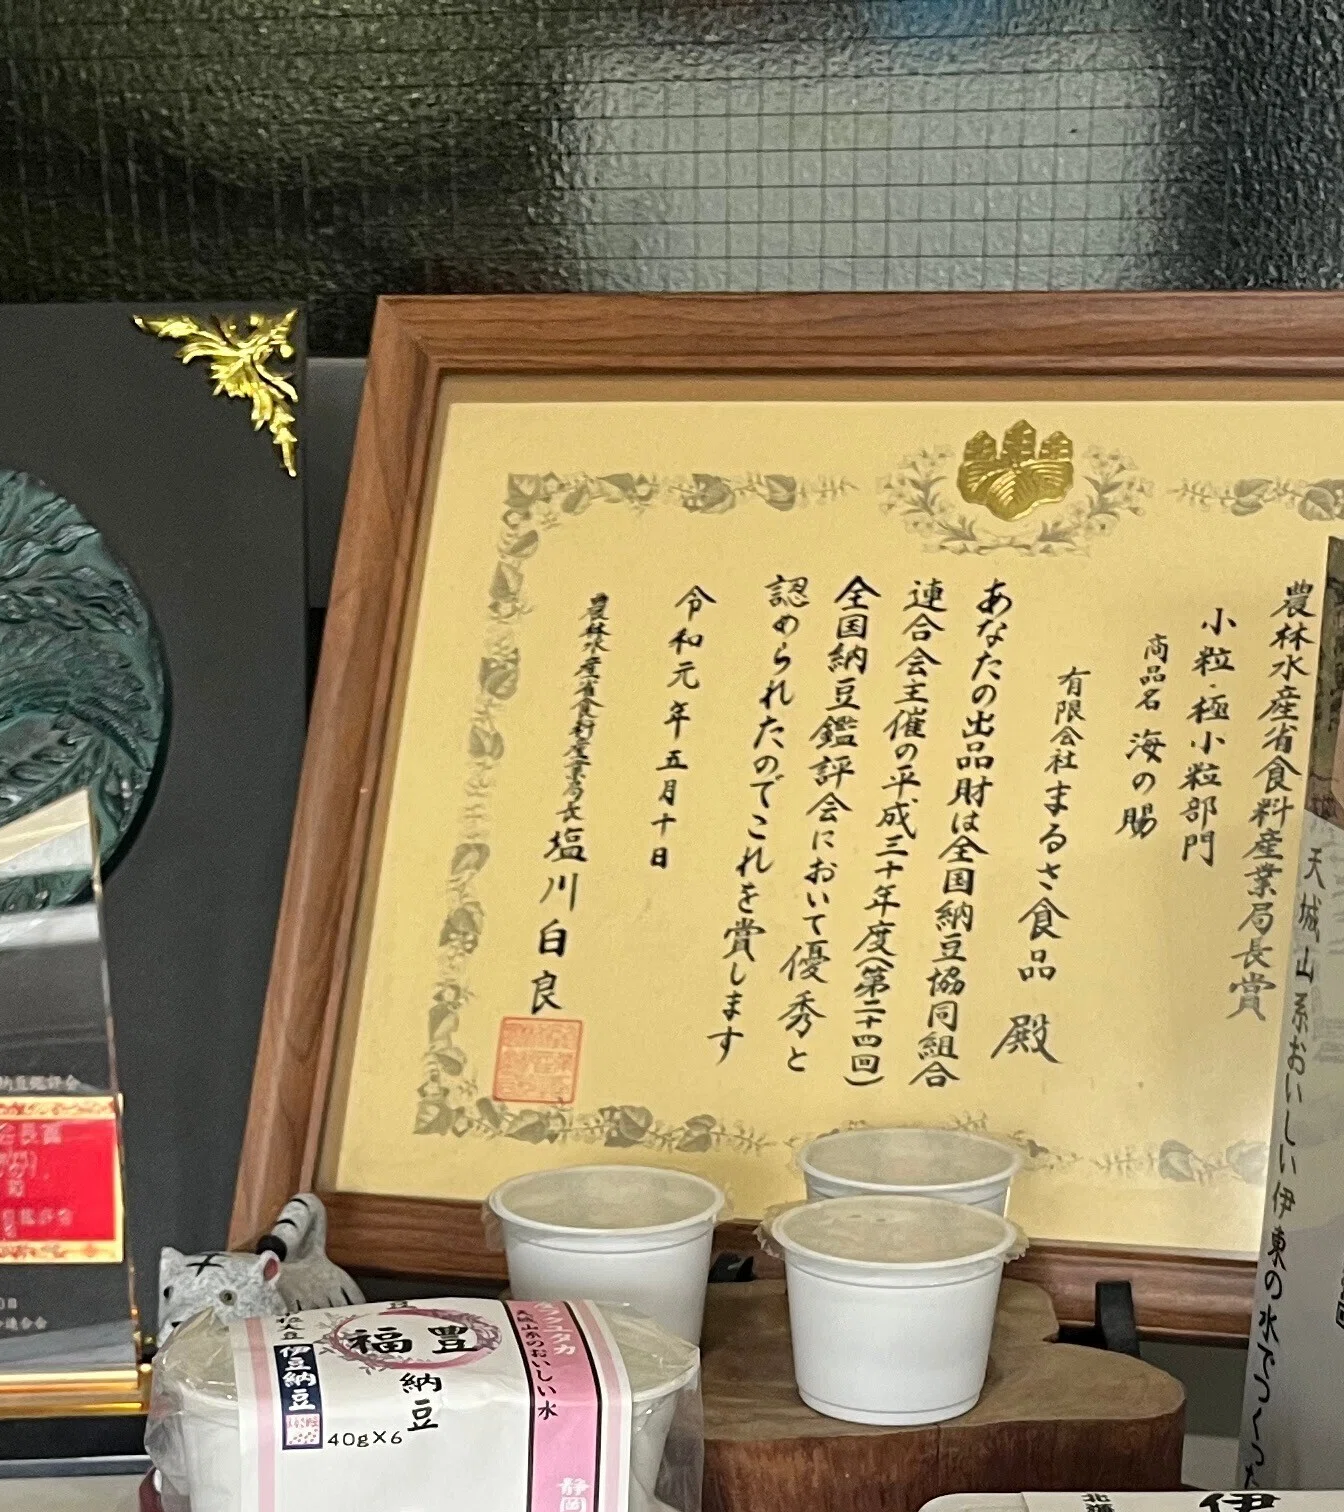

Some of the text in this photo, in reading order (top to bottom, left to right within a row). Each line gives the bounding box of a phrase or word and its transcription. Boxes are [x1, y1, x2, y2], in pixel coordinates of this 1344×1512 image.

[650, 585, 717, 870] 令和元年五月十日
[706, 573, 810, 1067] 認められたのでこれを賞します
[777, 575, 882, 1073] 全国納豆鑑評会において優秀と
[908, 578, 1013, 1088] あなたの出品財は全国納豆協同組合
[990, 666, 1092, 1065] 有限会社まるさ食品 殿
[1178, 607, 1237, 867] 小粒・極小粒部門
[1226, 578, 1317, 1022] 農林水産省食料産業局長賞
[279, 1346, 317, 1411] 伊豆納豆
[399, 1372, 443, 1432] 納豆
